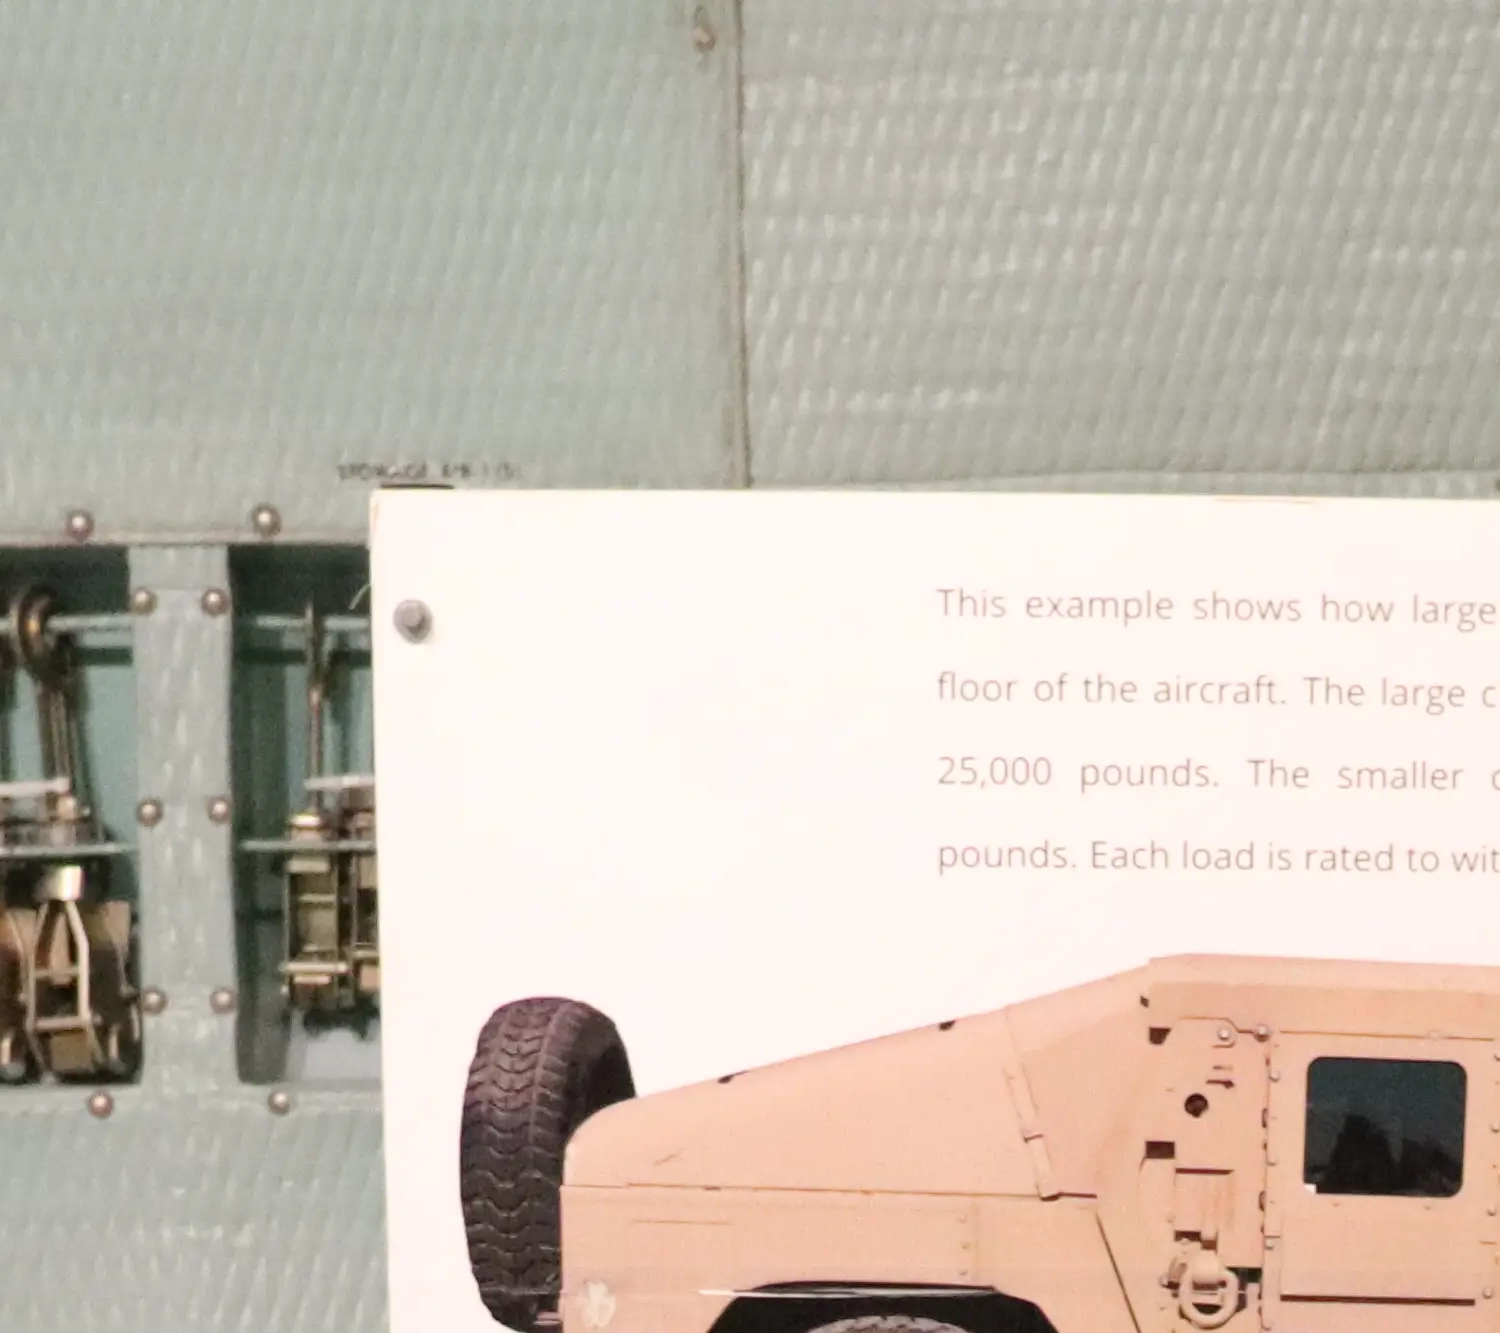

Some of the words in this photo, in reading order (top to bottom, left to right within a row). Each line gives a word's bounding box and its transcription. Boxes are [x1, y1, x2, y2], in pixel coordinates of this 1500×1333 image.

[935, 586, 1007, 619] This
[1025, 589, 1175, 629] example
[1191, 589, 1302, 623] shows
[1320, 592, 1396, 624] how
[1412, 593, 1498, 634] large
[936, 670, 1019, 703] floor
[1033, 671, 1069, 703] of
[1081, 672, 1139, 704] the
[1153, 673, 1286, 706] aircraft.
[1302, 675, 1366, 708] The
[1380, 676, 1466, 717] large
[937, 755, 1053, 790] 25,000
[1080, 757, 1219, 795] pounds.
[1246, 757, 1310, 790] The
[1336, 759, 1465, 792] smaller
[937, 838, 1077, 877] pounds.
[1090, 839, 1171, 871] Each
[1182, 839, 1255, 871] load
[1267, 841, 1293, 872] is
[1304, 842, 1395, 873] rated
[1406, 847, 1441, 874] to
